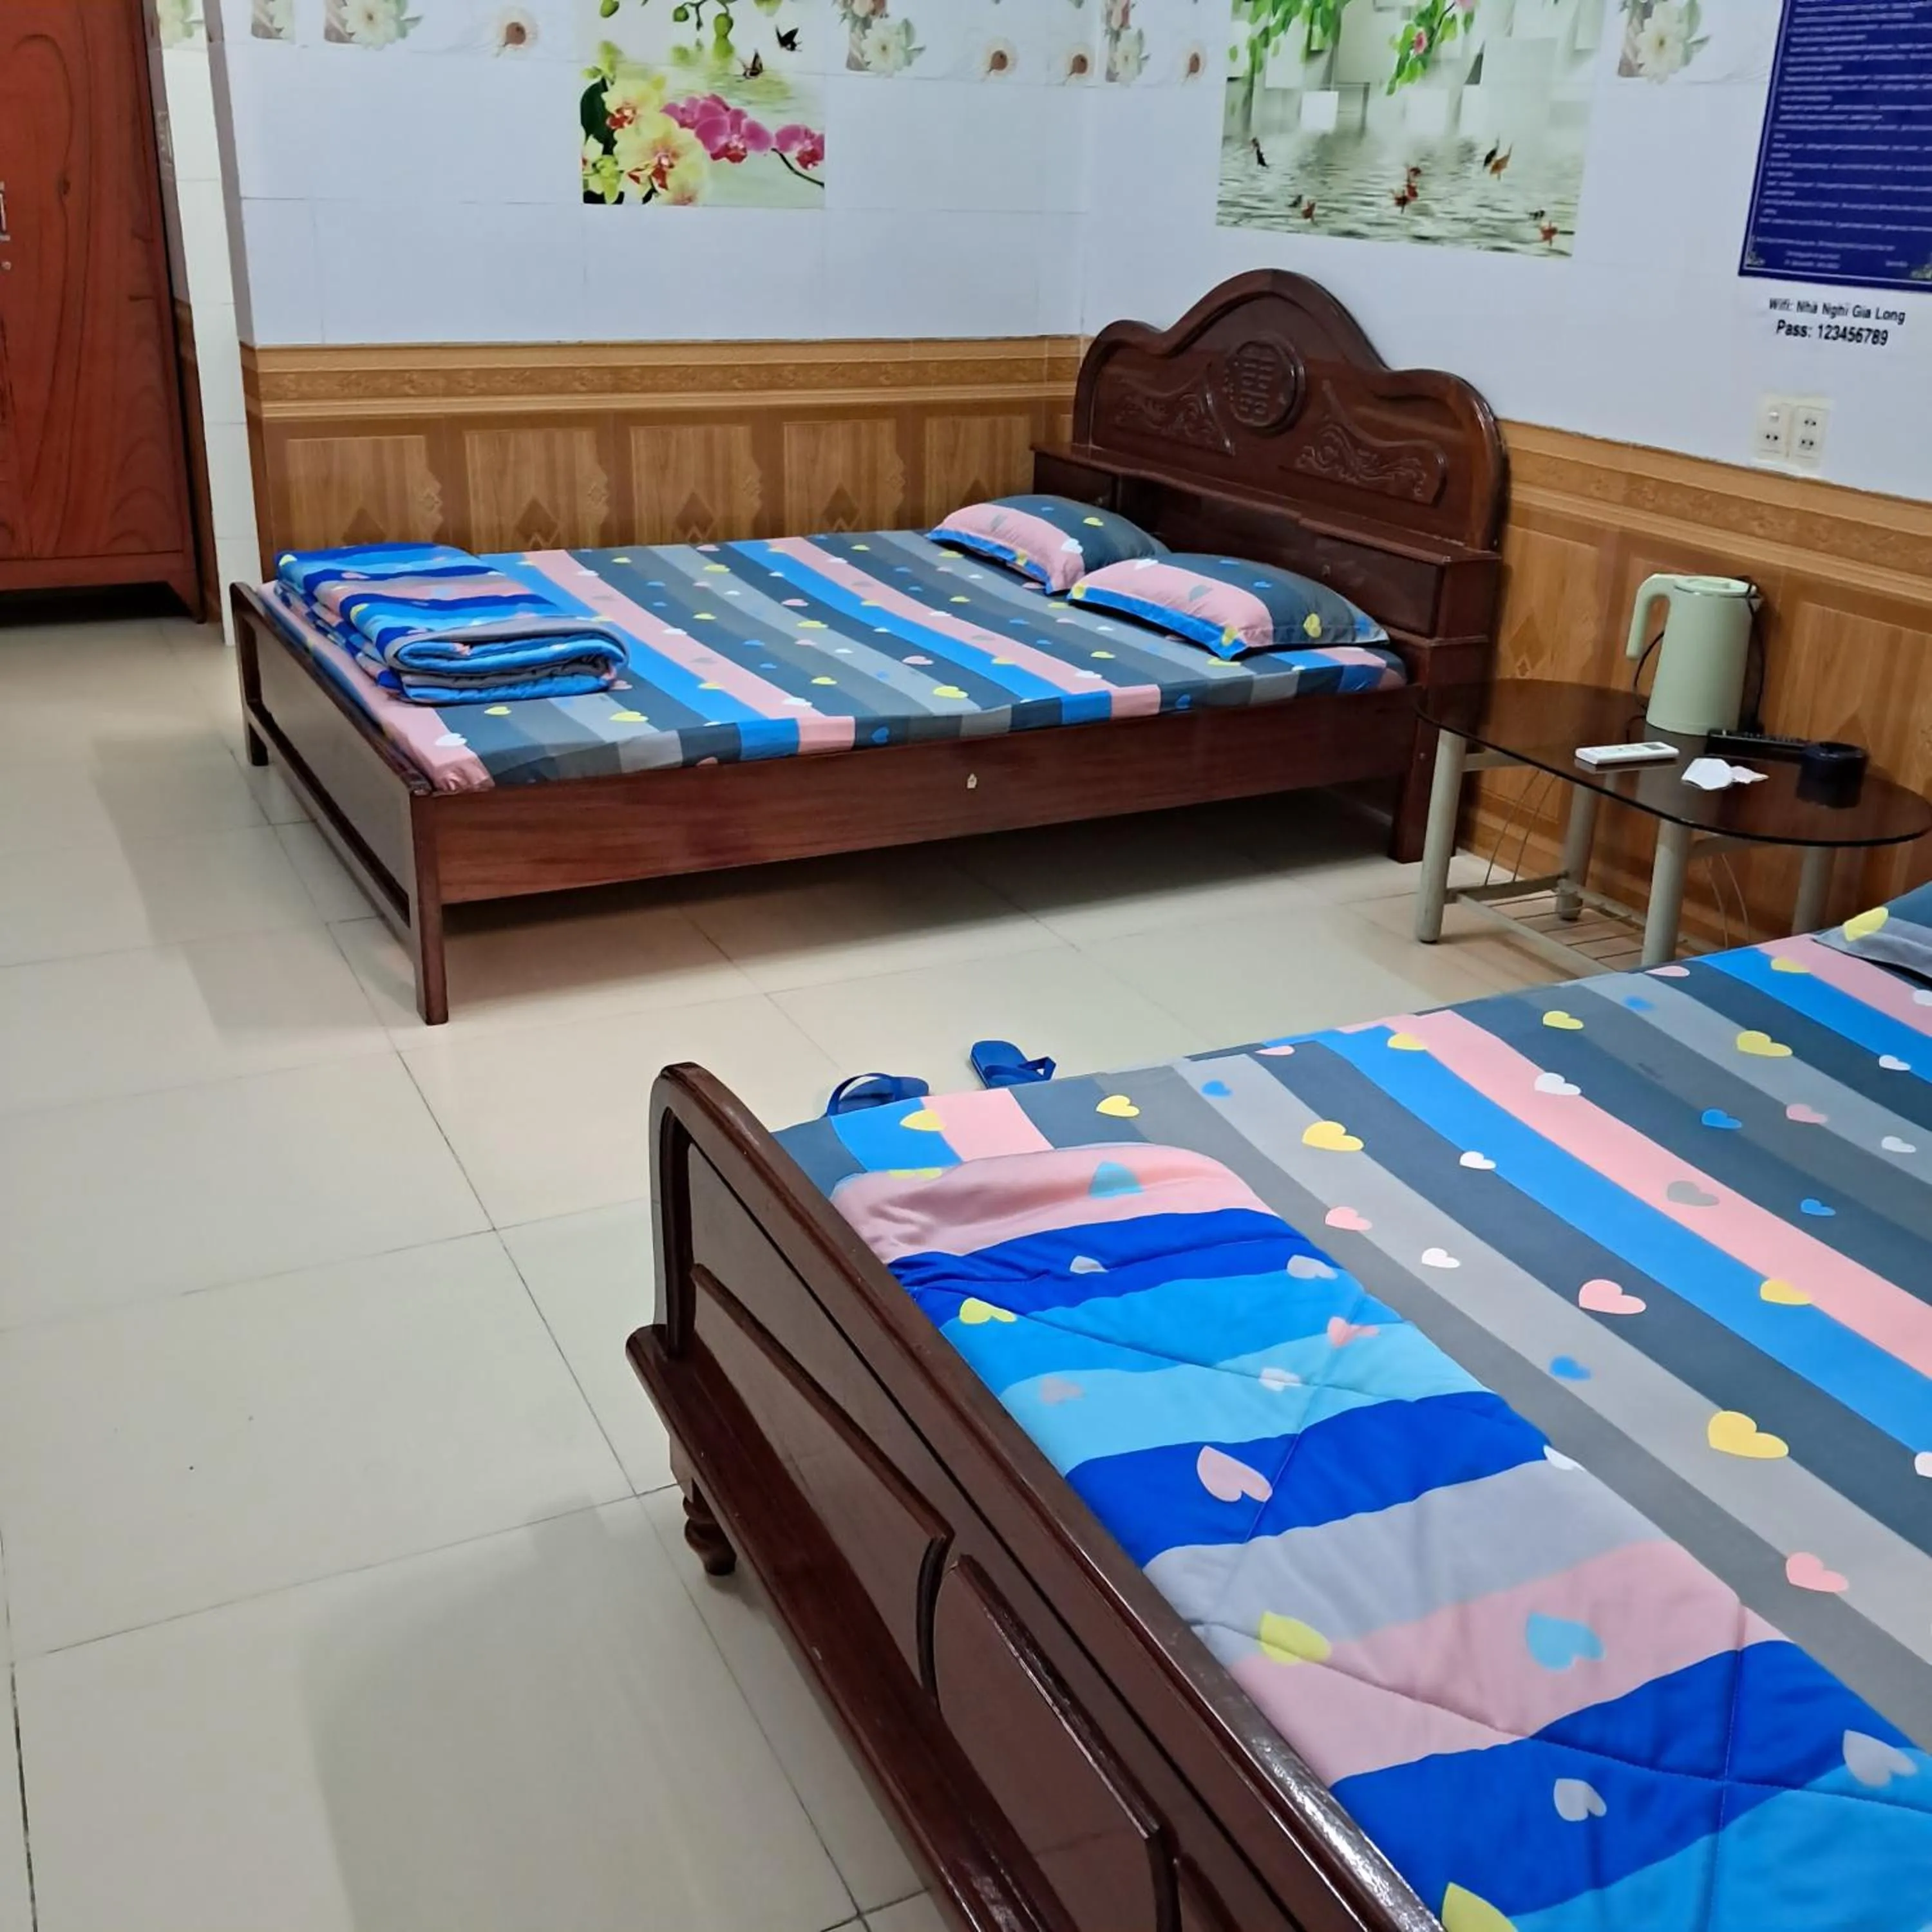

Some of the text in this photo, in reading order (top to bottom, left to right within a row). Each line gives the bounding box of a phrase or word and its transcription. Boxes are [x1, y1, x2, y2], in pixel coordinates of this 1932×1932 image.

[1852, 304, 1871, 319] Gia
[1875, 307, 1906, 325] Long
[1776, 319, 1888, 346] Pass: 123456789
